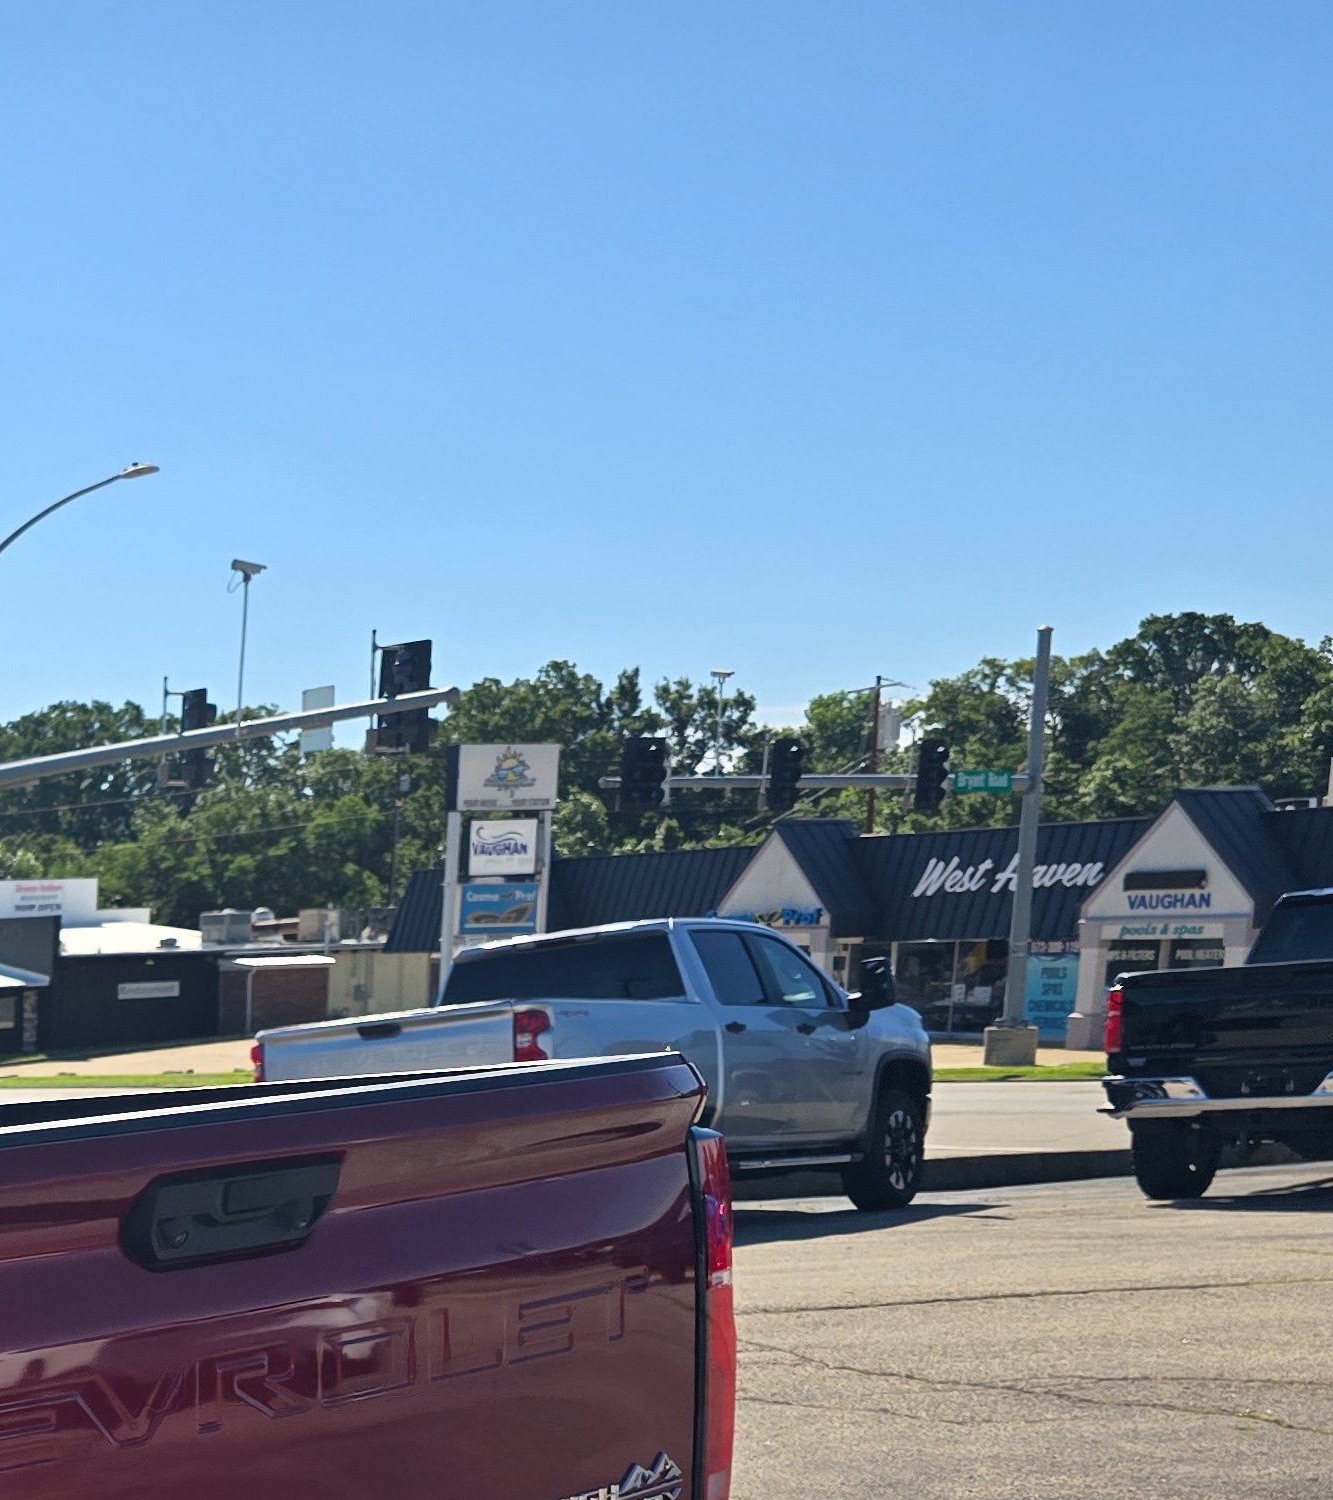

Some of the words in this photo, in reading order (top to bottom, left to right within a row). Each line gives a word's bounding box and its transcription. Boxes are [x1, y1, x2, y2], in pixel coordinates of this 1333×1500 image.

[988, 772, 1008, 788] Road
[472, 841, 528, 856] VAUGHAN
[912, 855, 994, 897] West
[1128, 892, 1212, 910] VAUGHAN
[1118, 921, 1157, 940] pools
[1171, 925, 1204, 939] spas
